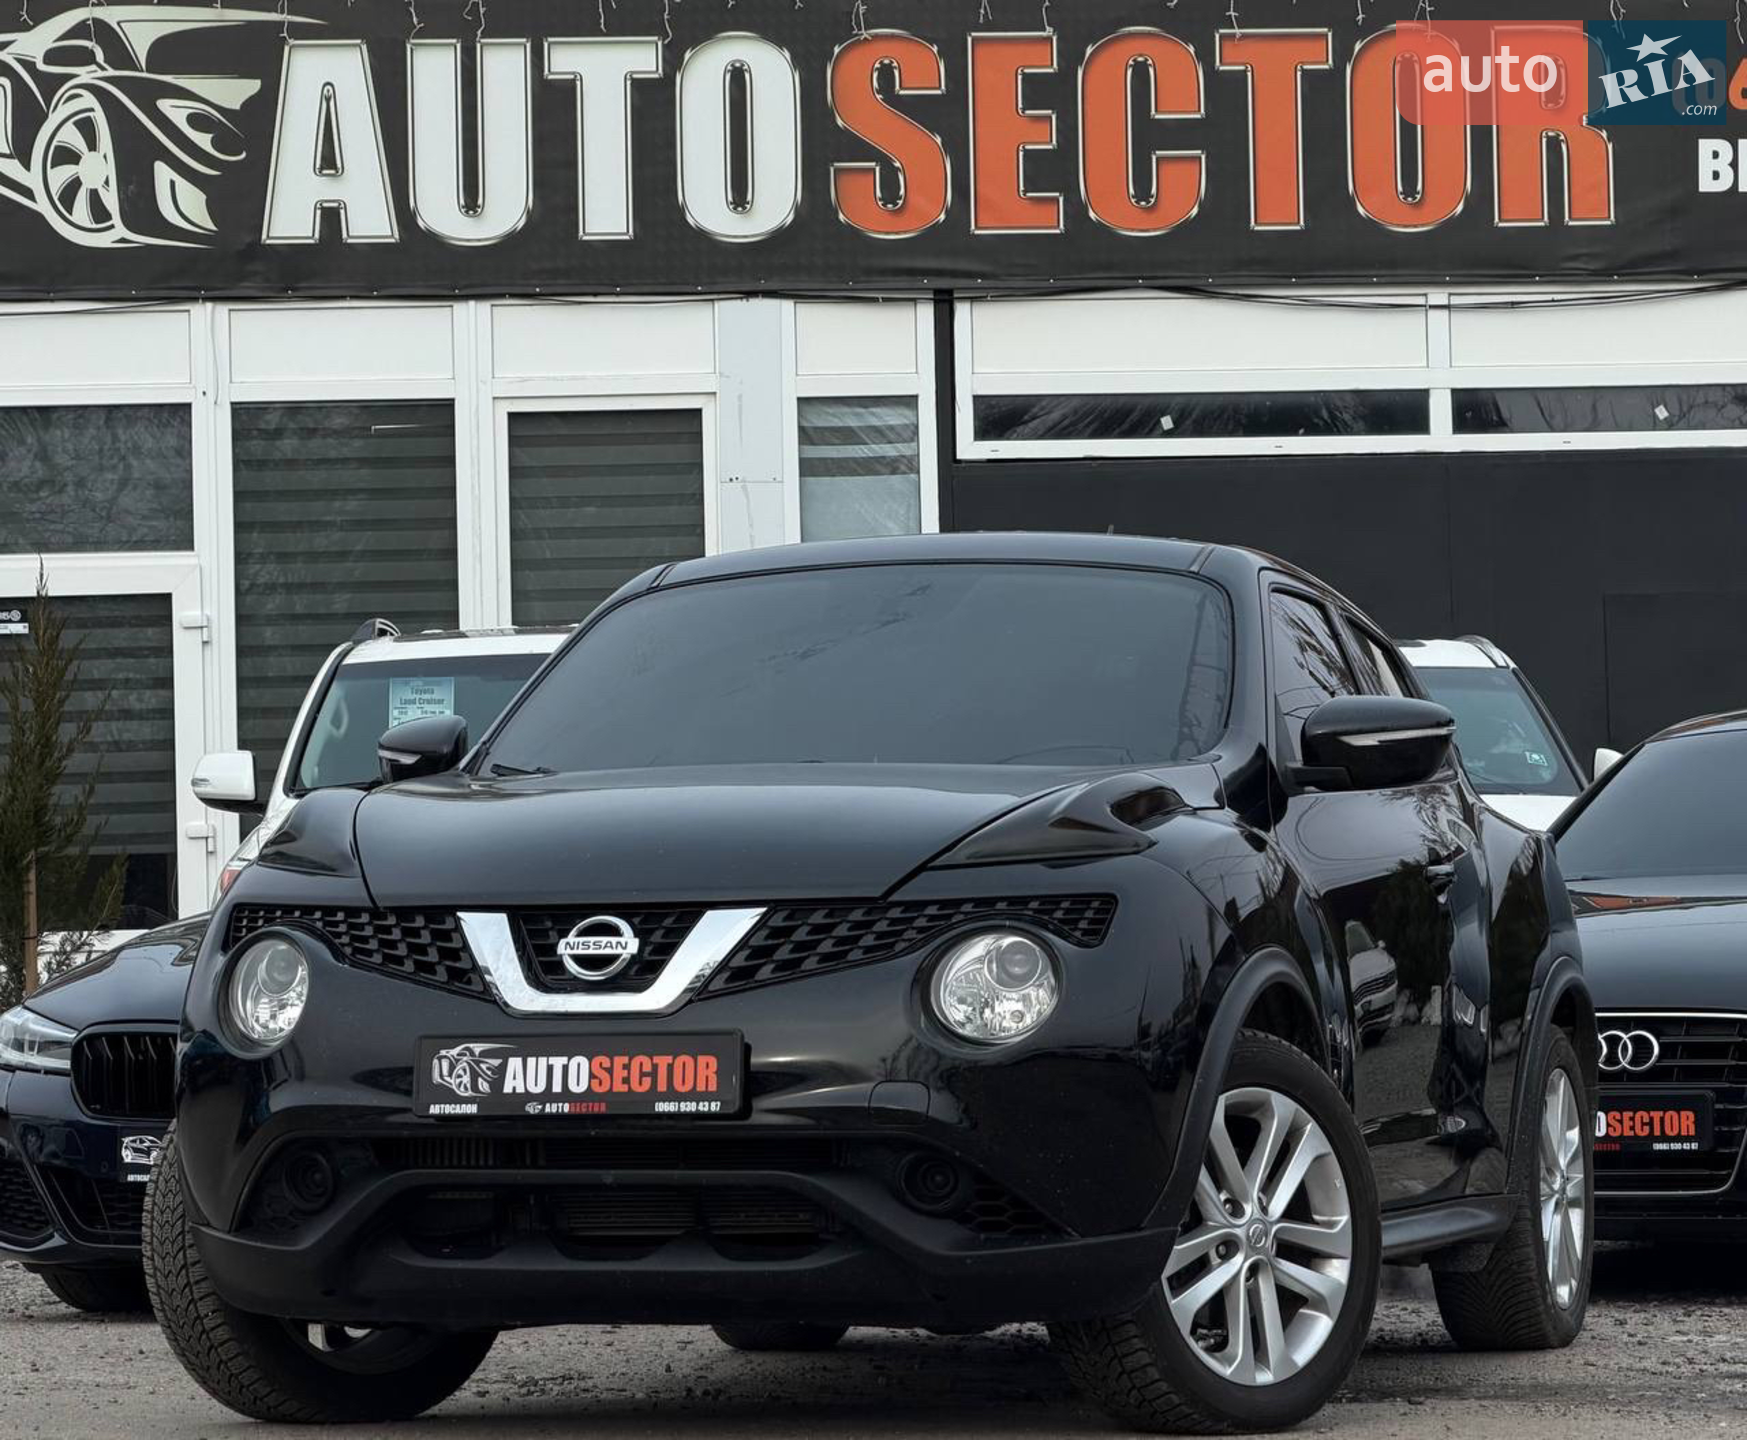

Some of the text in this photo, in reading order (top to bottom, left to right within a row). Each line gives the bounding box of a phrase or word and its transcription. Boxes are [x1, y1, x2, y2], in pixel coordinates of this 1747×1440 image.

[260, 25, 1615, 244] AUTOSECTOR
[564, 940, 628, 951] NISSAN
[502, 1055, 718, 1094] AUTOSECTOR
[680, 1101, 697, 1112] 930
[698, 1101, 709, 1112] 43
